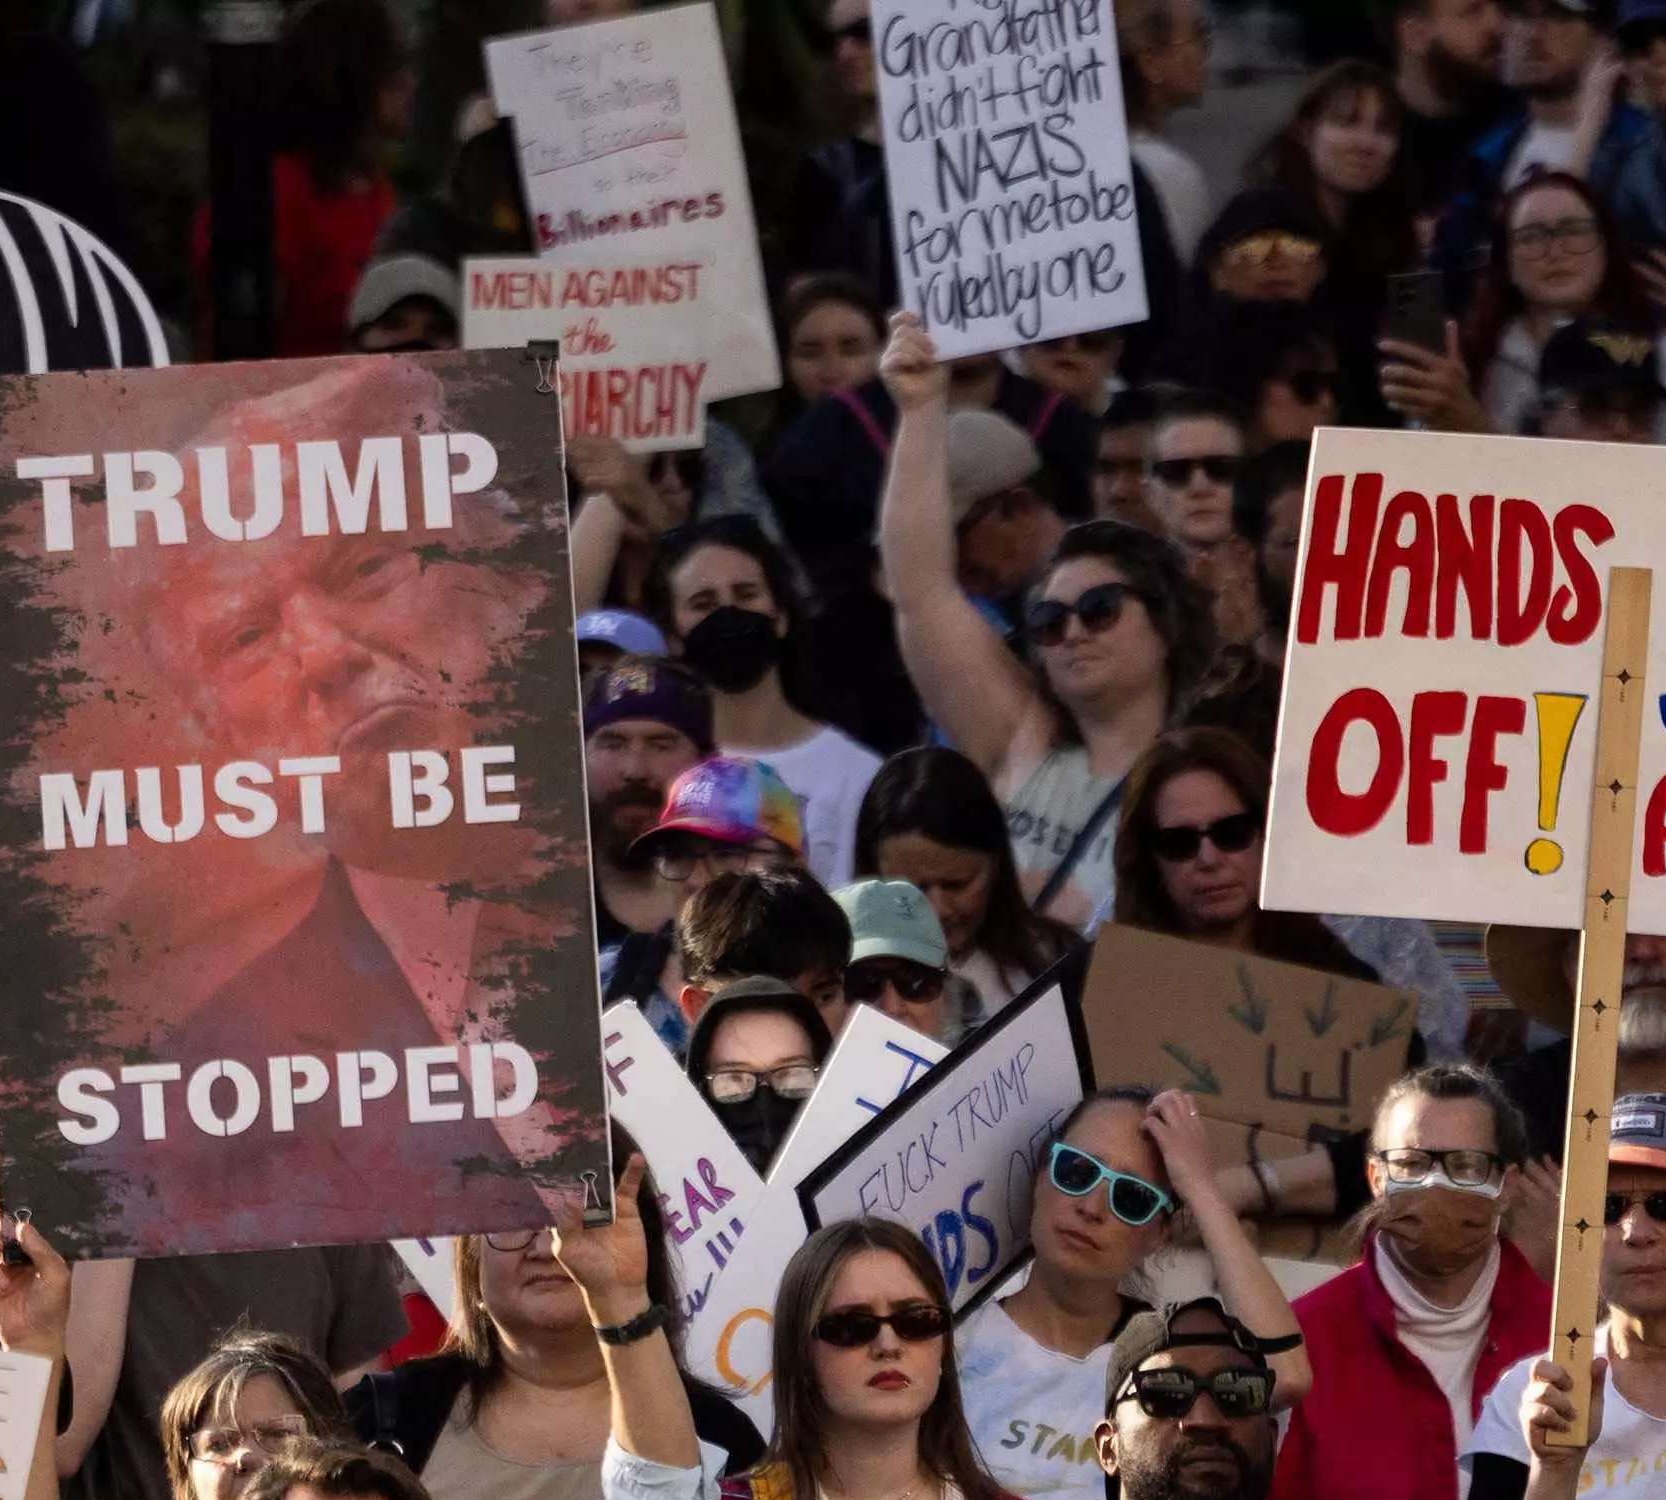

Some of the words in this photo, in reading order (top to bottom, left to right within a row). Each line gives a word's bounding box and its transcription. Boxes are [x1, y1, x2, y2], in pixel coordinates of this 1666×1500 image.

[881, 0, 1102, 77] Grandfather
[935, 111, 1086, 213] NAZIS
[536, 192, 727, 250] Billionaires
[470, 271, 553, 310] MEN
[560, 264, 703, 309] AGAINST
[563, 317, 617, 356] the
[16, 433, 499, 552] TRUMP
[1297, 471, 1617, 648] HANDS
[40, 756, 341, 851] MUST
[388, 745, 521, 829] BE
[1304, 685, 1590, 877] OFF!
[56, 1043, 539, 1146] STOPPED
[859, 1121, 947, 1218] FUCK
[947, 1042, 1035, 1151] TRUMP
